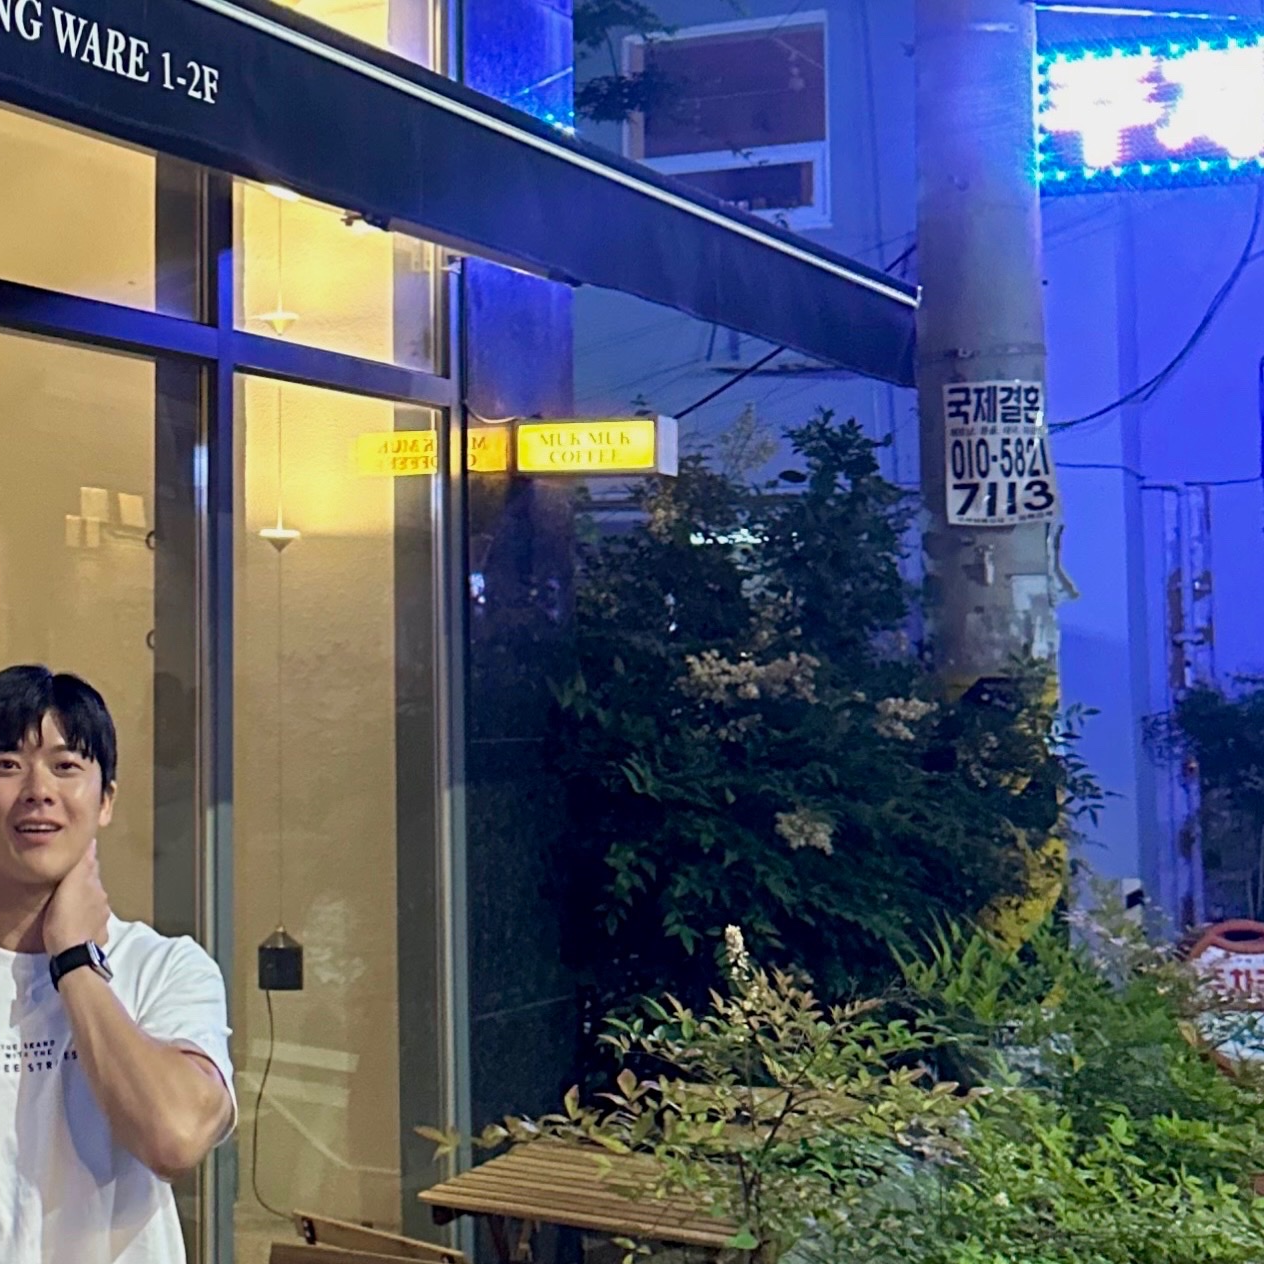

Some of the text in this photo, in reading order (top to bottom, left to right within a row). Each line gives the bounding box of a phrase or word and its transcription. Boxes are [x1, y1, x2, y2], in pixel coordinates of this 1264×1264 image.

[52, 7, 150, 82] WARE
[161, 52, 220, 104] 1-2F
[947, 385, 1040, 424] 국제결혼
[540, 431, 631, 447] MUK MUK
[951, 437, 1049, 480] 010-5821
[952, 480, 1054, 516] 7113
